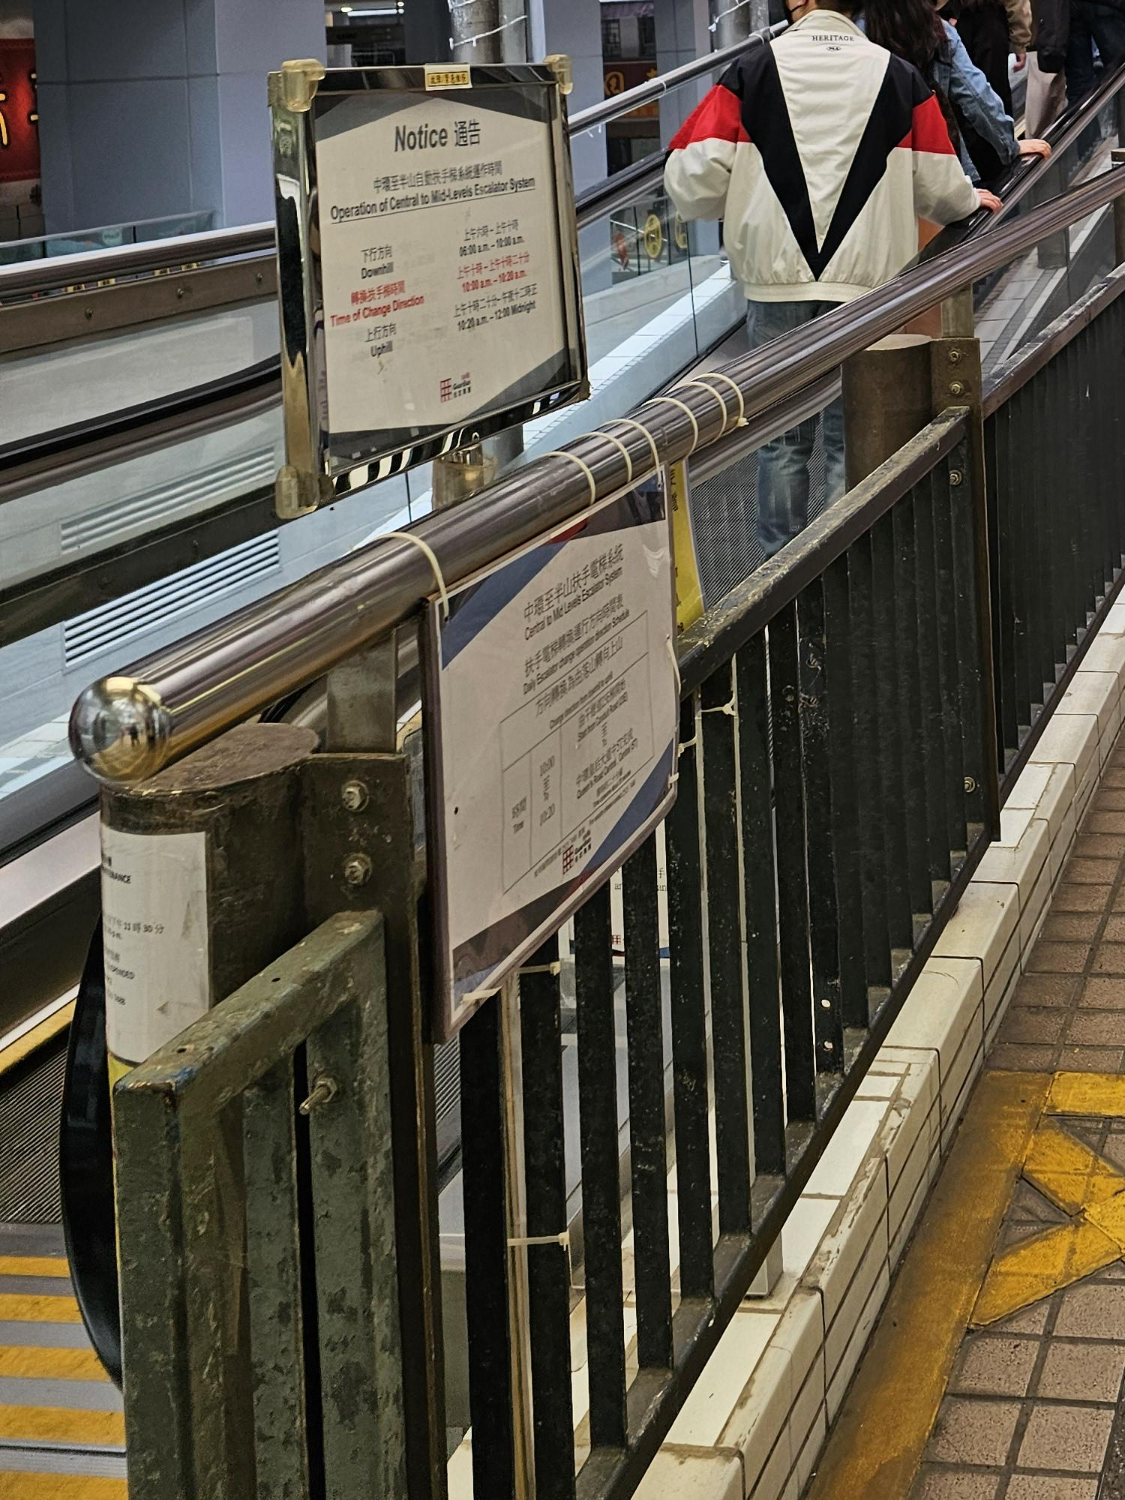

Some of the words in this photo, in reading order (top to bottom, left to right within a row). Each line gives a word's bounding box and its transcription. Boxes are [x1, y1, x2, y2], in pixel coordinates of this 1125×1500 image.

[812, 34, 854, 42] HERITAGE
[394, 123, 448, 152] Notice
[454, 119, 481, 147] 通告
[331, 202, 372, 222] Operation
[380, 198, 387, 212] of
[389, 192, 419, 210] Central
[420, 192, 429, 204] to
[430, 184, 472, 203] Mid-Levels
[474, 178, 508, 196] Escalator
[509, 175, 535, 193] System
[361, 244, 392, 264] 下行方向
[361, 261, 393, 279] Downhill
[330, 311, 350, 327] Time
[352, 309, 360, 321] of
[363, 301, 391, 322] Change
[392, 293, 424, 311] Direction
[365, 321, 396, 343] 上行方向
[370, 340, 392, 358] Uphill
[525, 616, 545, 641] Central
[547, 613, 551, 626] to
[564, 594, 581, 614] Levels
